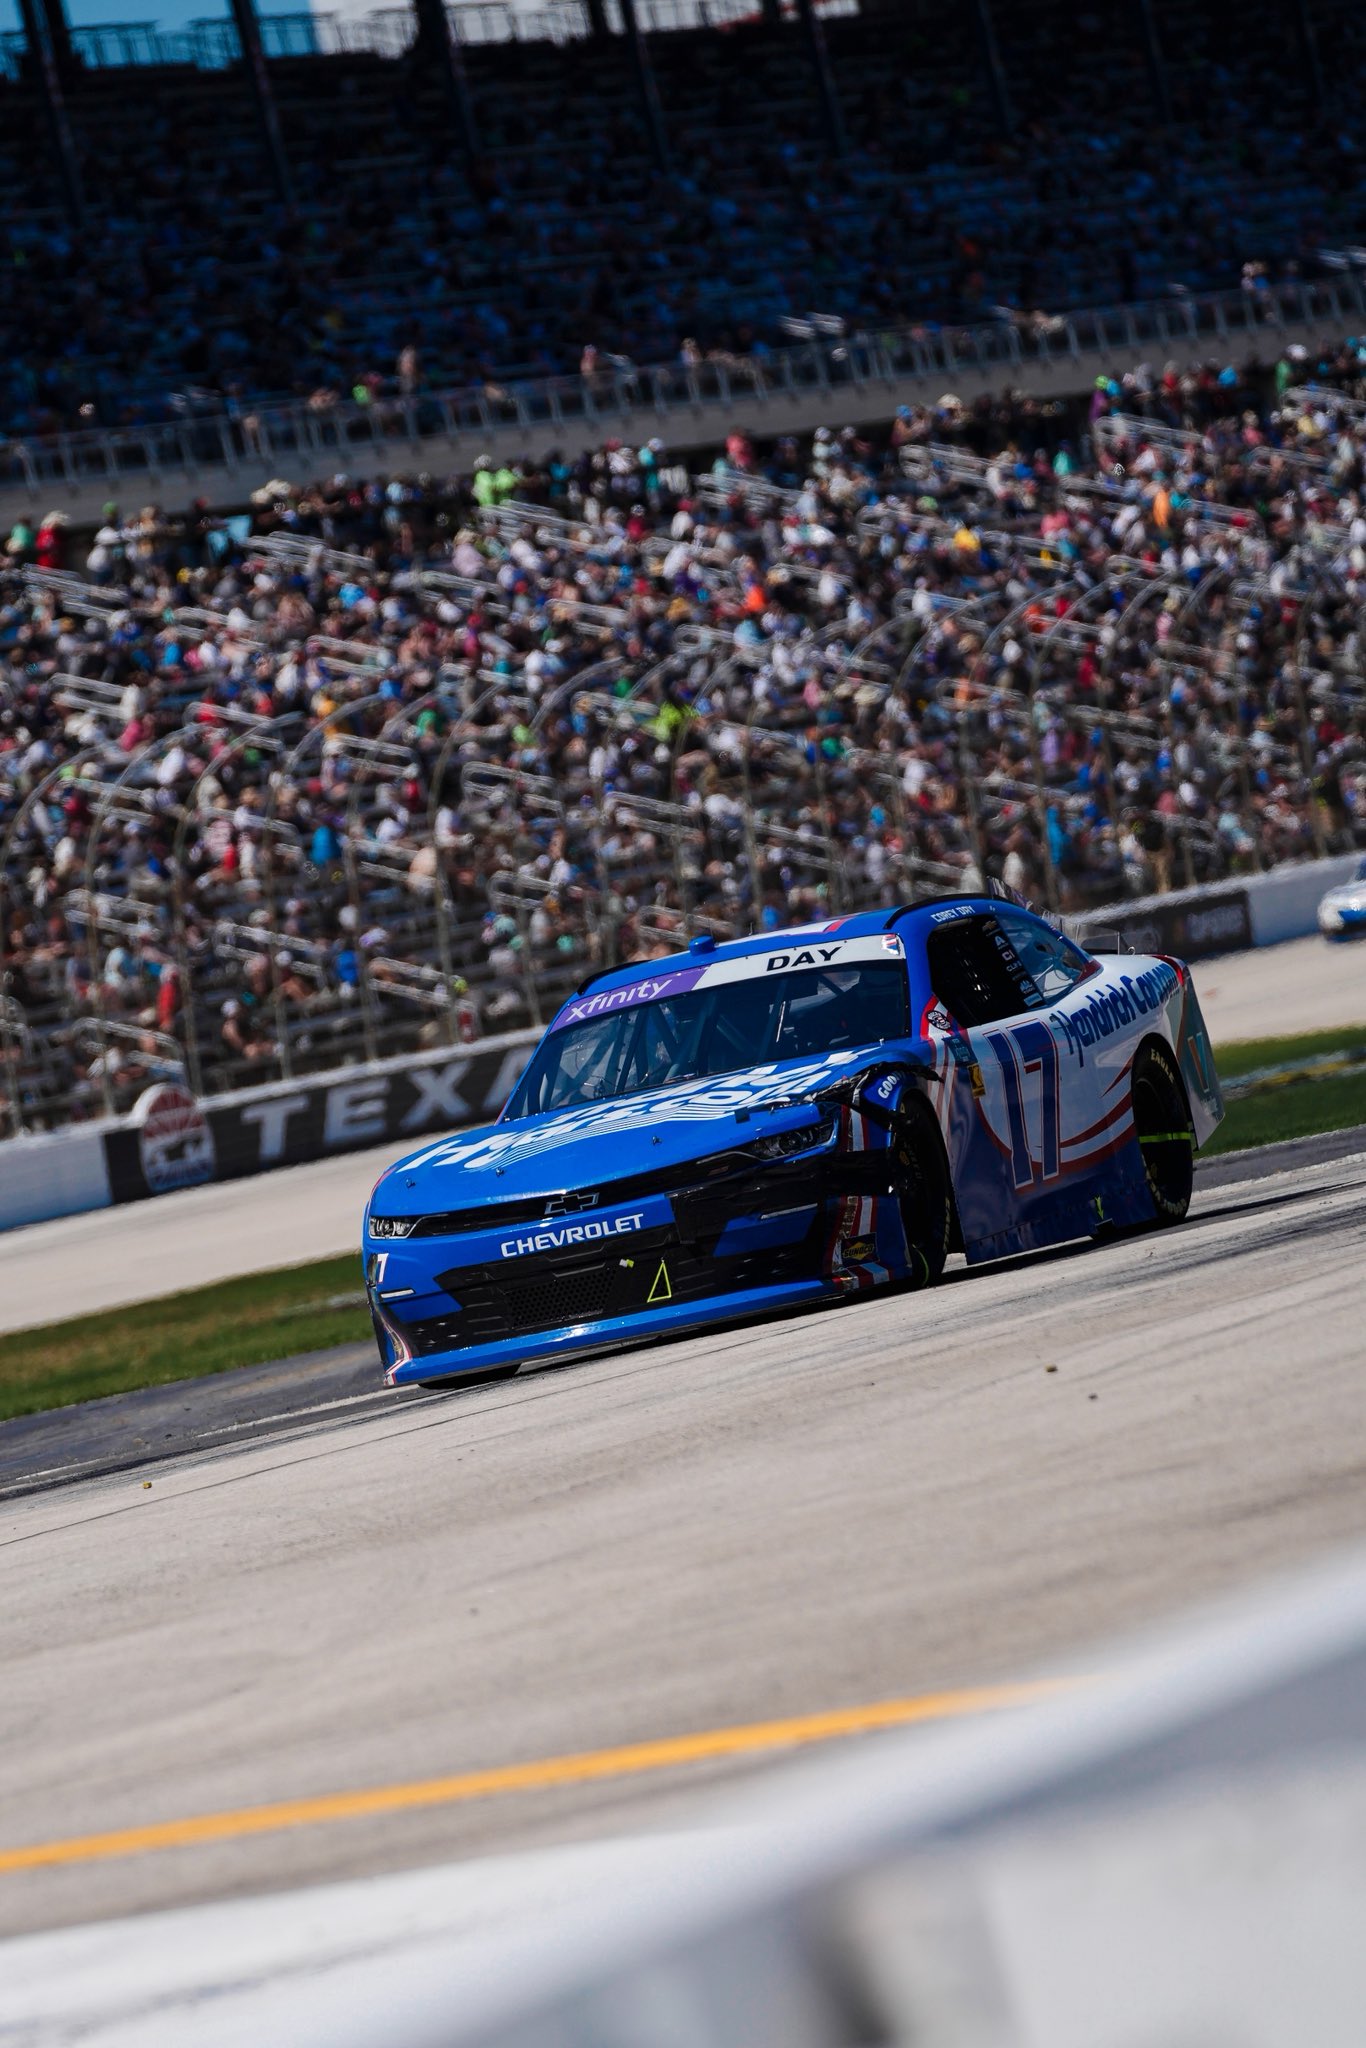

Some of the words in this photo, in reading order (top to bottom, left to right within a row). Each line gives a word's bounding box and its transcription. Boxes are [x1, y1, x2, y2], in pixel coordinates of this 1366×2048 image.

[766, 946, 843, 972] DAY
[566, 978, 673, 1022] xfinity
[983, 1017, 1061, 1190] 17
[501, 1212, 644, 1258] CHEVROLET
[843, 1243, 875, 1260] SUNOCO
